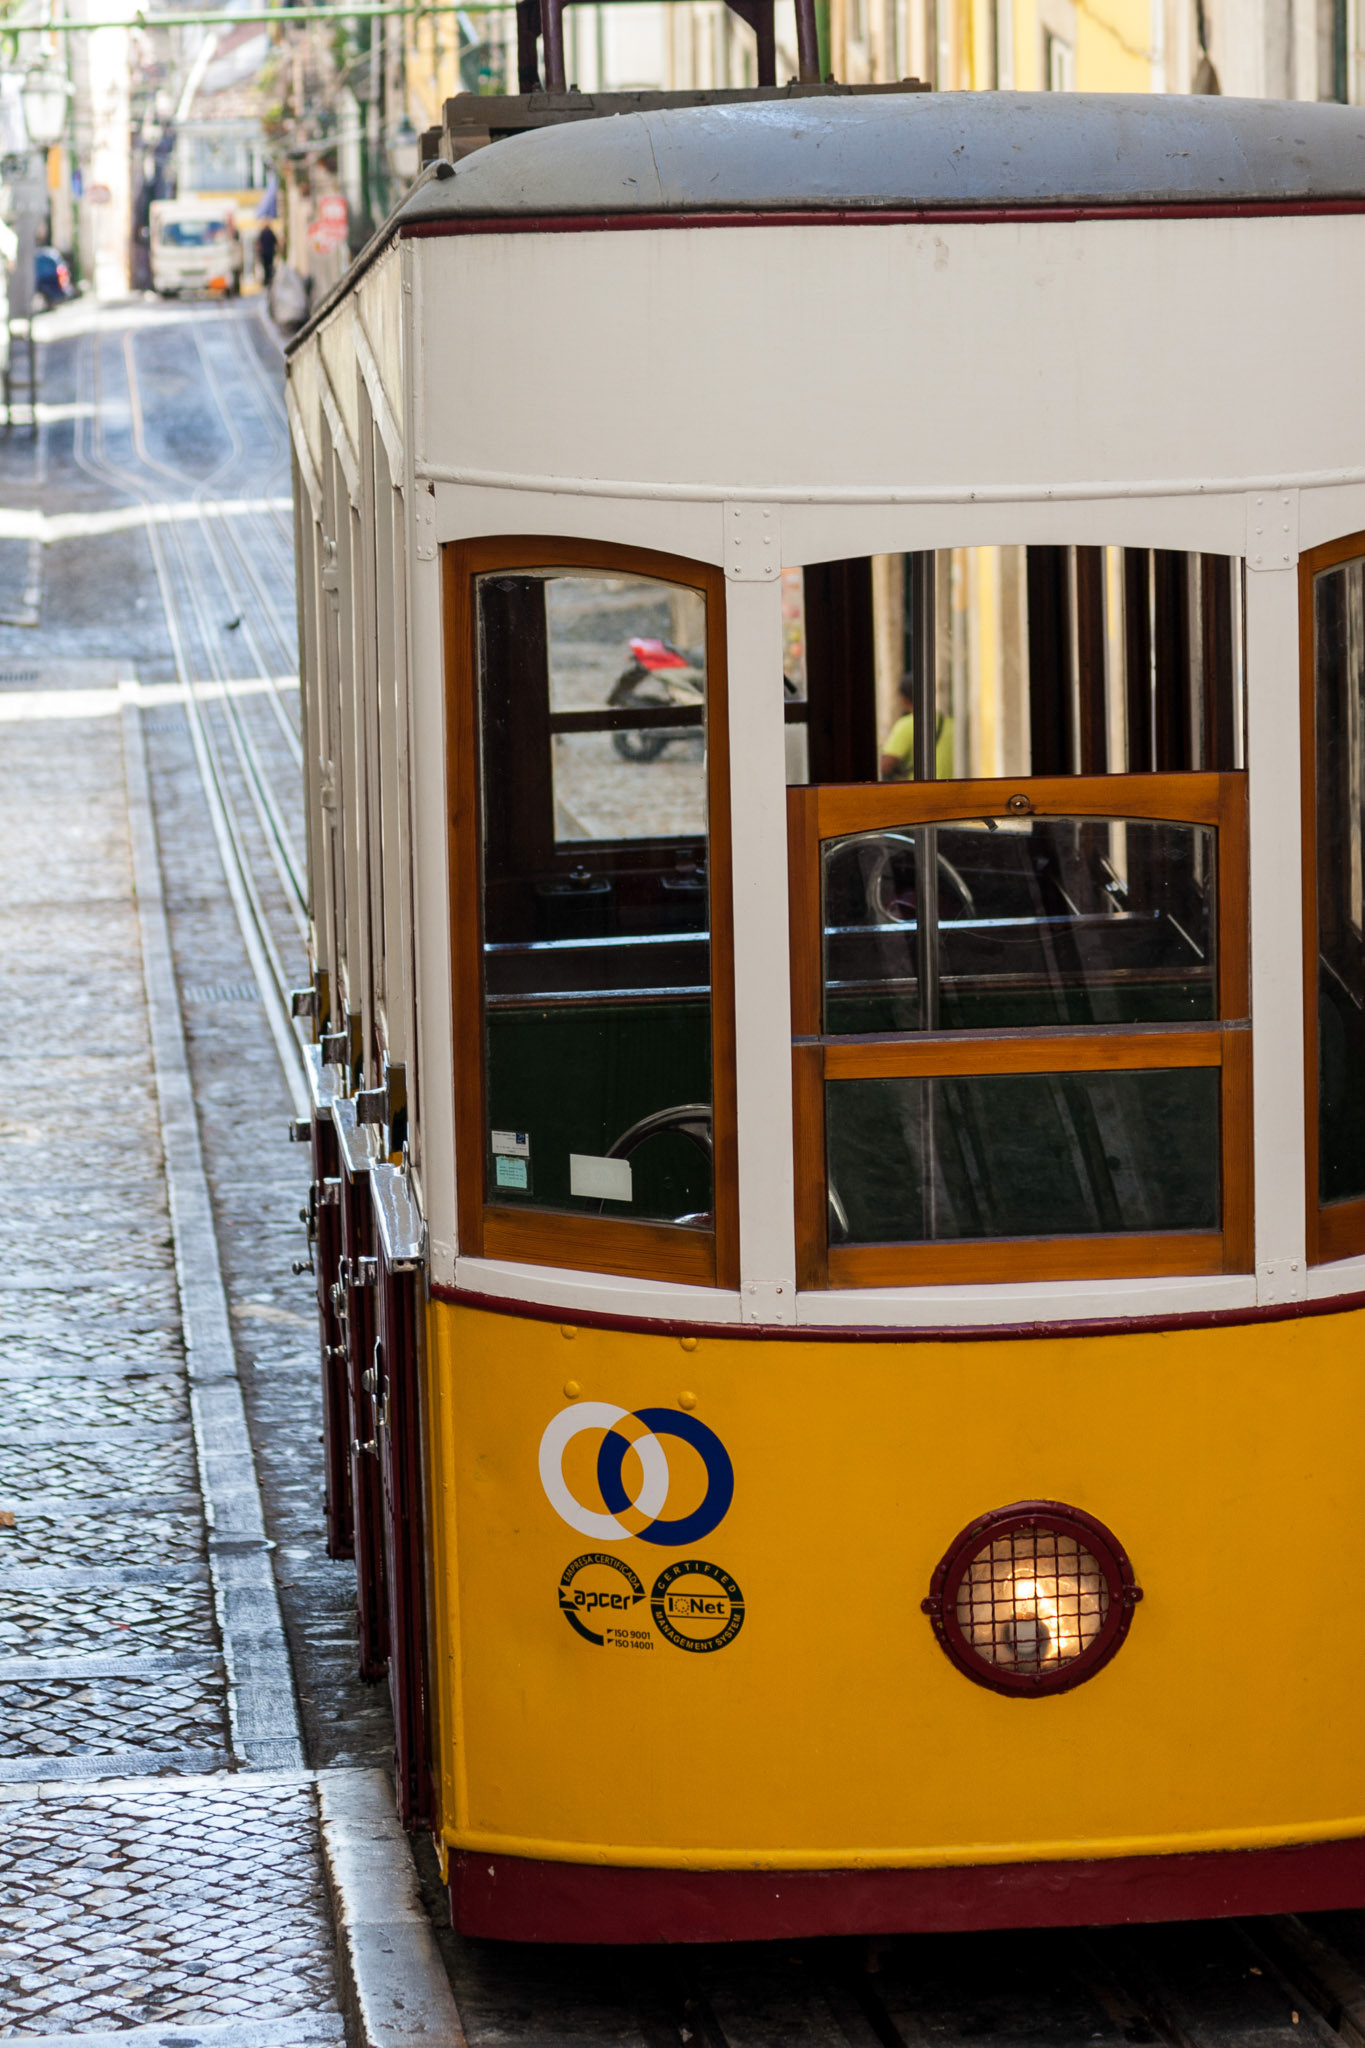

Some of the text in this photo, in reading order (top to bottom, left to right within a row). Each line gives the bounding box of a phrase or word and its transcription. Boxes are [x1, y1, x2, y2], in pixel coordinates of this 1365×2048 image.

[563, 1554, 641, 1591] EMPRESA CERTIFICADA
[658, 1563, 737, 1593] CERTIFIED
[573, 1589, 631, 1612] apcer
[614, 1629, 651, 1640] ISO 9001
[655, 1611, 742, 1651] MANAGEMENT SYSTEM
[615, 1639, 654, 1650] ISO 14001
